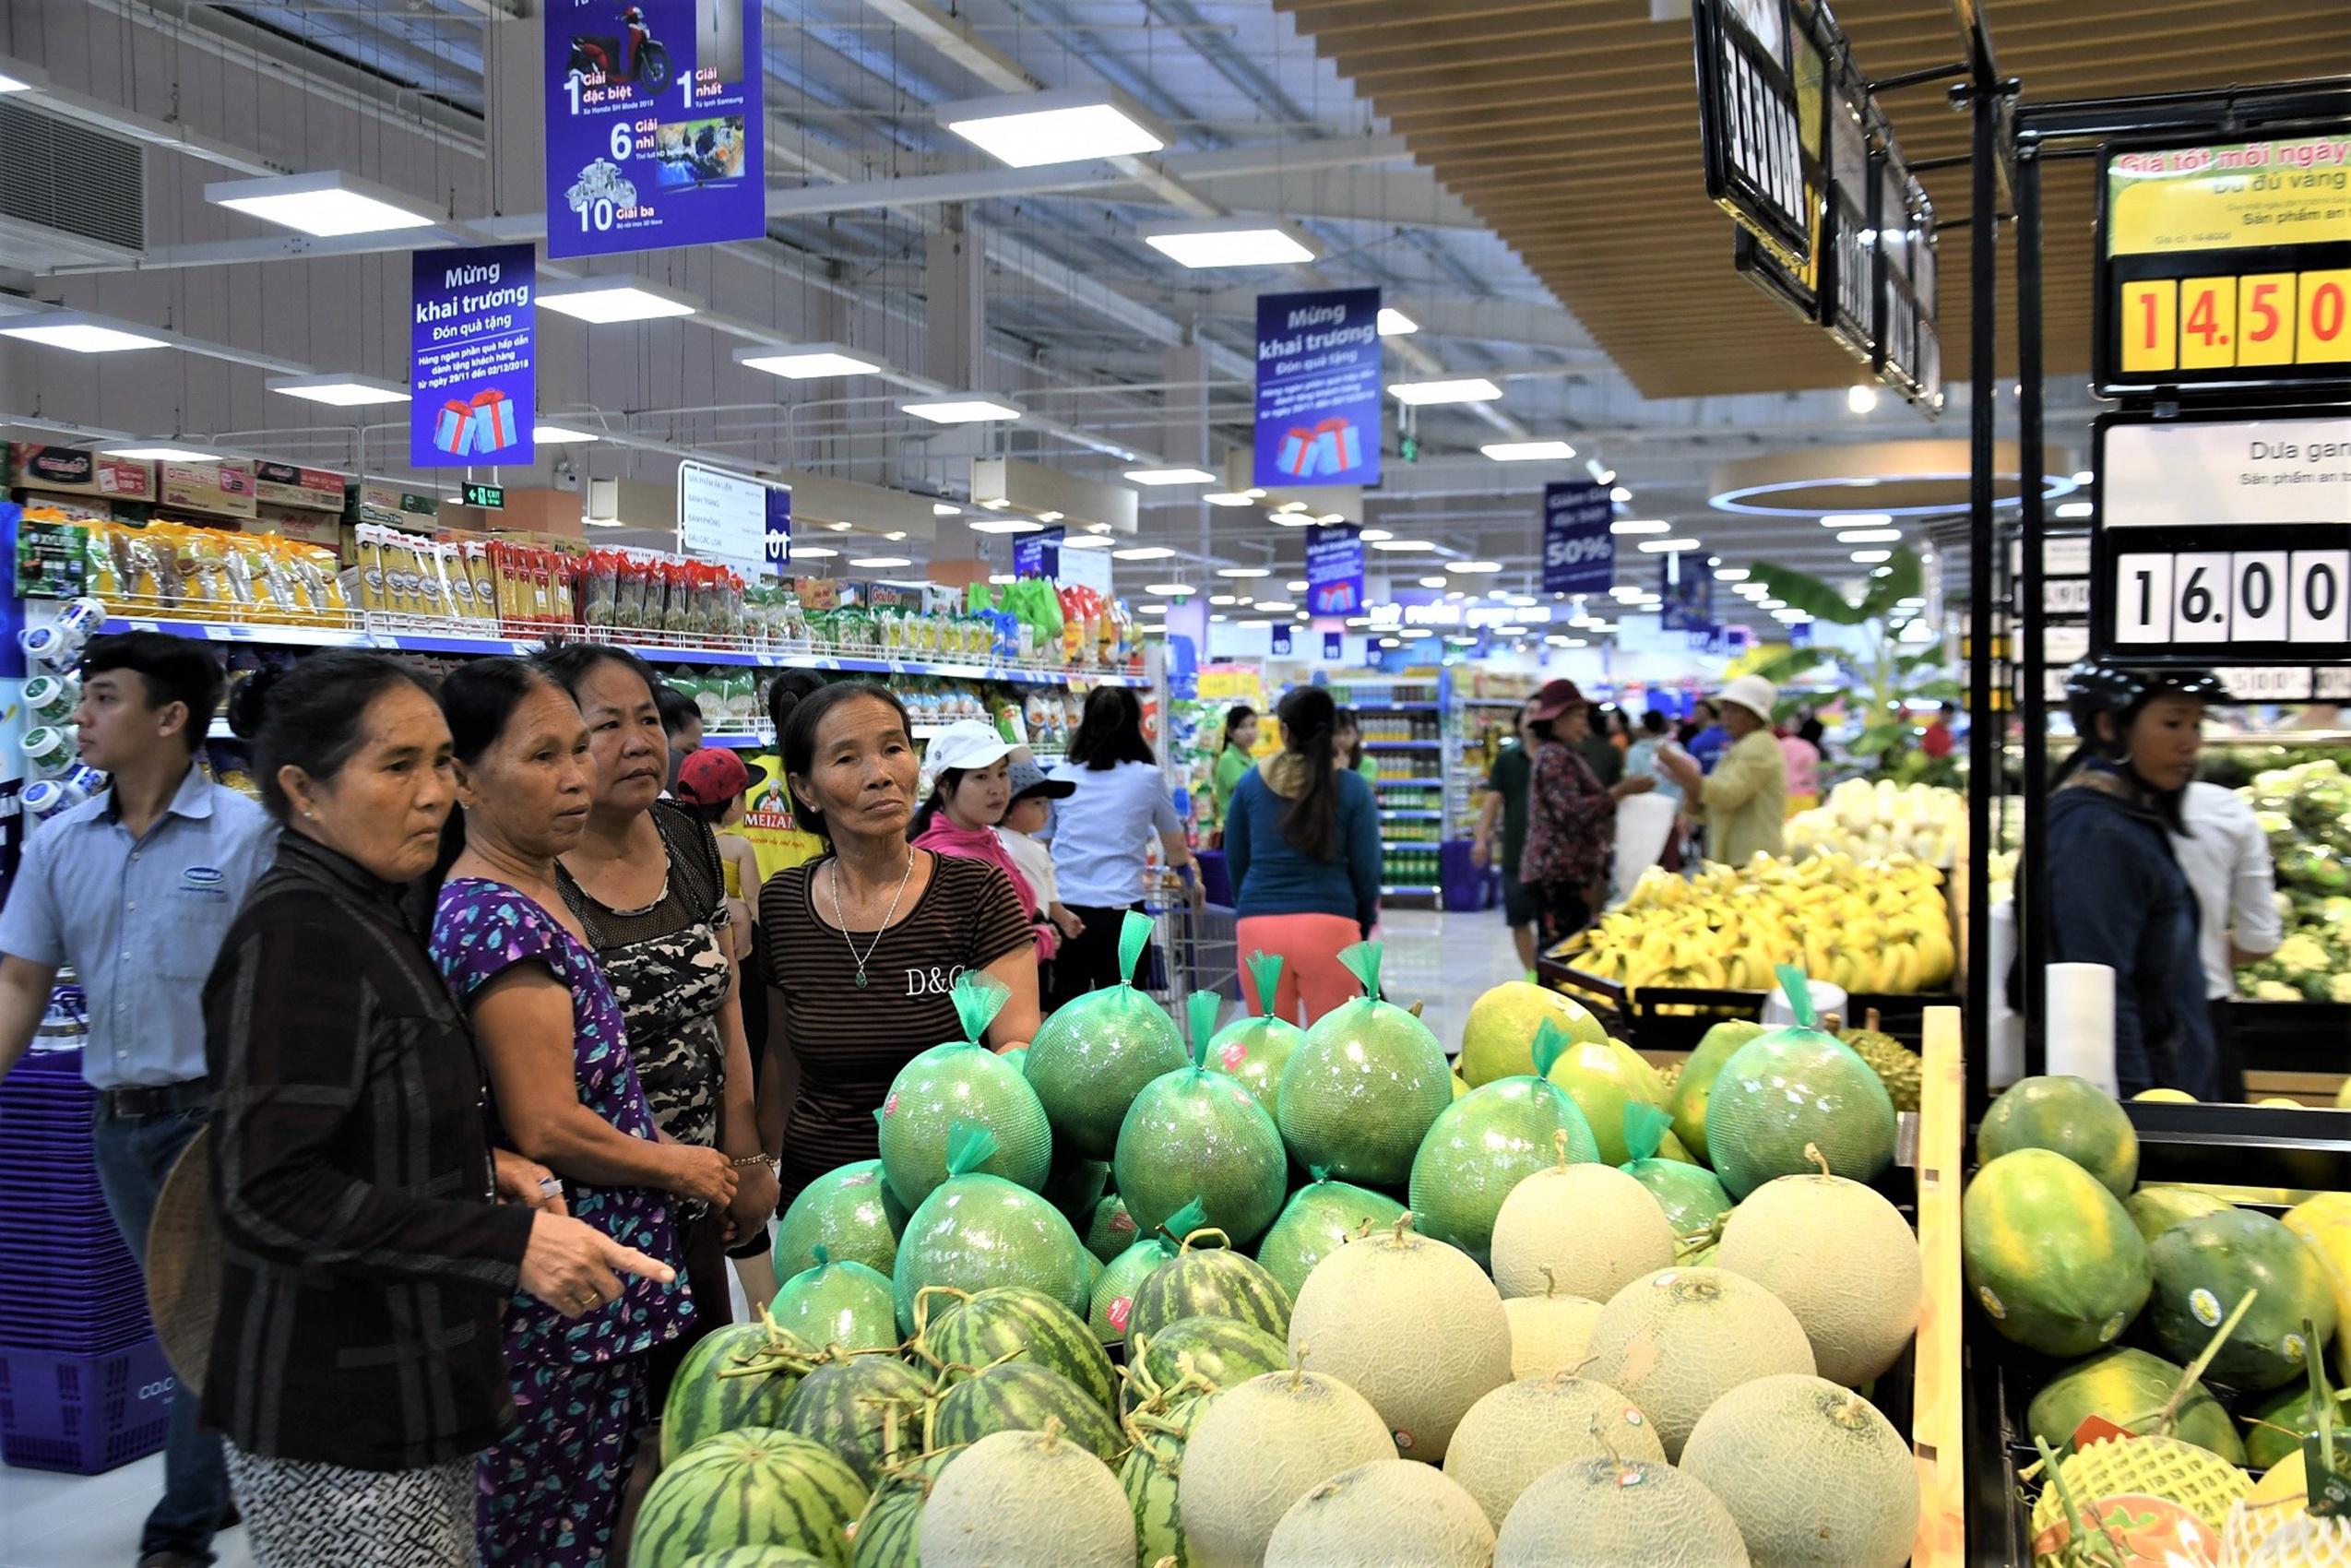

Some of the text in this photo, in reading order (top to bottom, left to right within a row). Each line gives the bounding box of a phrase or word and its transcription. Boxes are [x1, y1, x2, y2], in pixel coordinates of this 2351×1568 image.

[582, 71, 607, 87] Giải
[695, 66, 718, 81] Giải
[564, 75, 580, 115] 1
[582, 85, 633, 104] đặc biệt
[676, 70, 692, 109] 1
[695, 82, 722, 98] nhất
[591, 104, 611, 114] Honda
[635, 118, 658, 133] Giải
[611, 122, 633, 160] 6
[635, 135, 654, 149] nhì
[2119, 150, 2164, 174] Giá
[2172, 147, 2212, 172] tốt
[576, 197, 613, 232] 10
[640, 205, 655, 218] ba
[2325, 208, 2345, 220] an
[445, 263, 501, 290] Mừng
[416, 285, 528, 323] khai trương
[433, 314, 512, 340] Đón quà tặng
[418, 354, 439, 366] Hàng
[440, 350, 459, 362] ngàn
[461, 345, 481, 360] phần
[481, 342, 496, 354] quà
[1258, 323, 1376, 362] khai trương
[431, 364, 451, 375] dành
[471, 355, 494, 367] khách
[495, 351, 516, 362] hàng
[428, 376, 448, 388] ngày
[768, 529, 788, 560] 01
[1547, 534, 1613, 567] 50%
